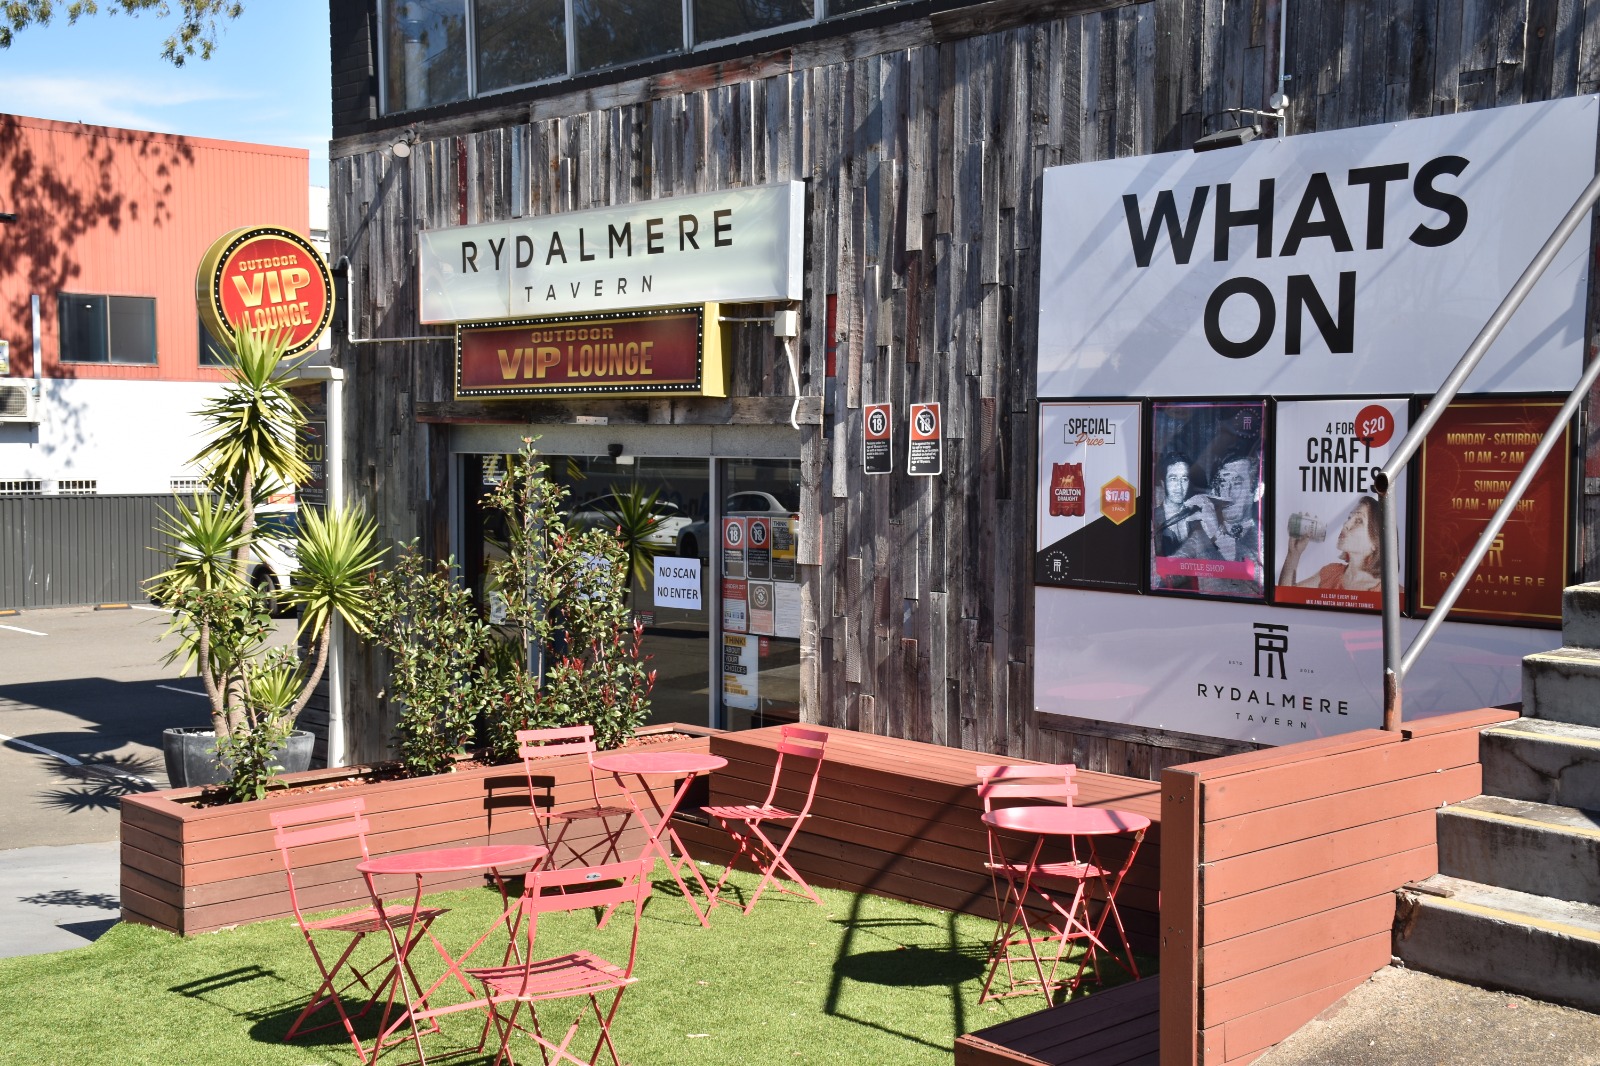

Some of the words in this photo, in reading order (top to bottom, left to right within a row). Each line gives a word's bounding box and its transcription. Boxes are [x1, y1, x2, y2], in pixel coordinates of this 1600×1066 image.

[1122, 155, 1470, 268] WHATS
[462, 209, 732, 273] RYDALMERE
[239, 255, 298, 272] OUTDOOR
[231, 267, 311, 308] VIP
[524, 275, 652, 303] TAVERN
[244, 302, 312, 332] LOUNGE
[1204, 271, 1356, 359] ON
[531, 327, 614, 344] OUTDOOR
[498, 346, 561, 380] VIP
[567, 341, 654, 378] LOUNGE
[872, 419, 883, 431] 18
[1068, 418, 1112, 434] SPECIAL
[1326, 422, 1332, 435] 4
[1335, 422, 1355, 435] FOR
[1362, 416, 1385, 436] $20
[1074, 432, 1105, 447] Price
[1447, 433, 1485, 445] MONDAY
[1494, 433, 1543, 445] SATURDAY
[1307, 437, 1374, 463] CRAFT
[1464, 451, 1475, 463] 10
[1477, 452, 1492, 463] AM
[1500, 452, 1507, 463] 2
[1509, 452, 1525, 463] AM
[1054, 488, 1081, 496] CARLTON
[1474, 480, 1511, 492] SUNDAY
[1105, 490, 1131, 502] $17.49
[1451, 497, 1462, 510] 10
[1464, 498, 1479, 510] AM
[730, 530, 739, 541] 18
[659, 566, 672, 578] NO
[673, 567, 697, 579] SCAN
[1180, 562, 1204, 571] BOTTLE
[1205, 564, 1225, 573] SHOP
[1440, 572, 1545, 587] RALMERE
[657, 586, 669, 597] NO
[670, 587, 699, 600] ENTER
[1466, 588, 1517, 596] TAVERN
[725, 655, 738, 663] YOUR
[724, 664, 747, 674] CHOICES
[1197, 683, 1348, 716] RYDALMERE
[1236, 713, 1307, 729] TAVERN
